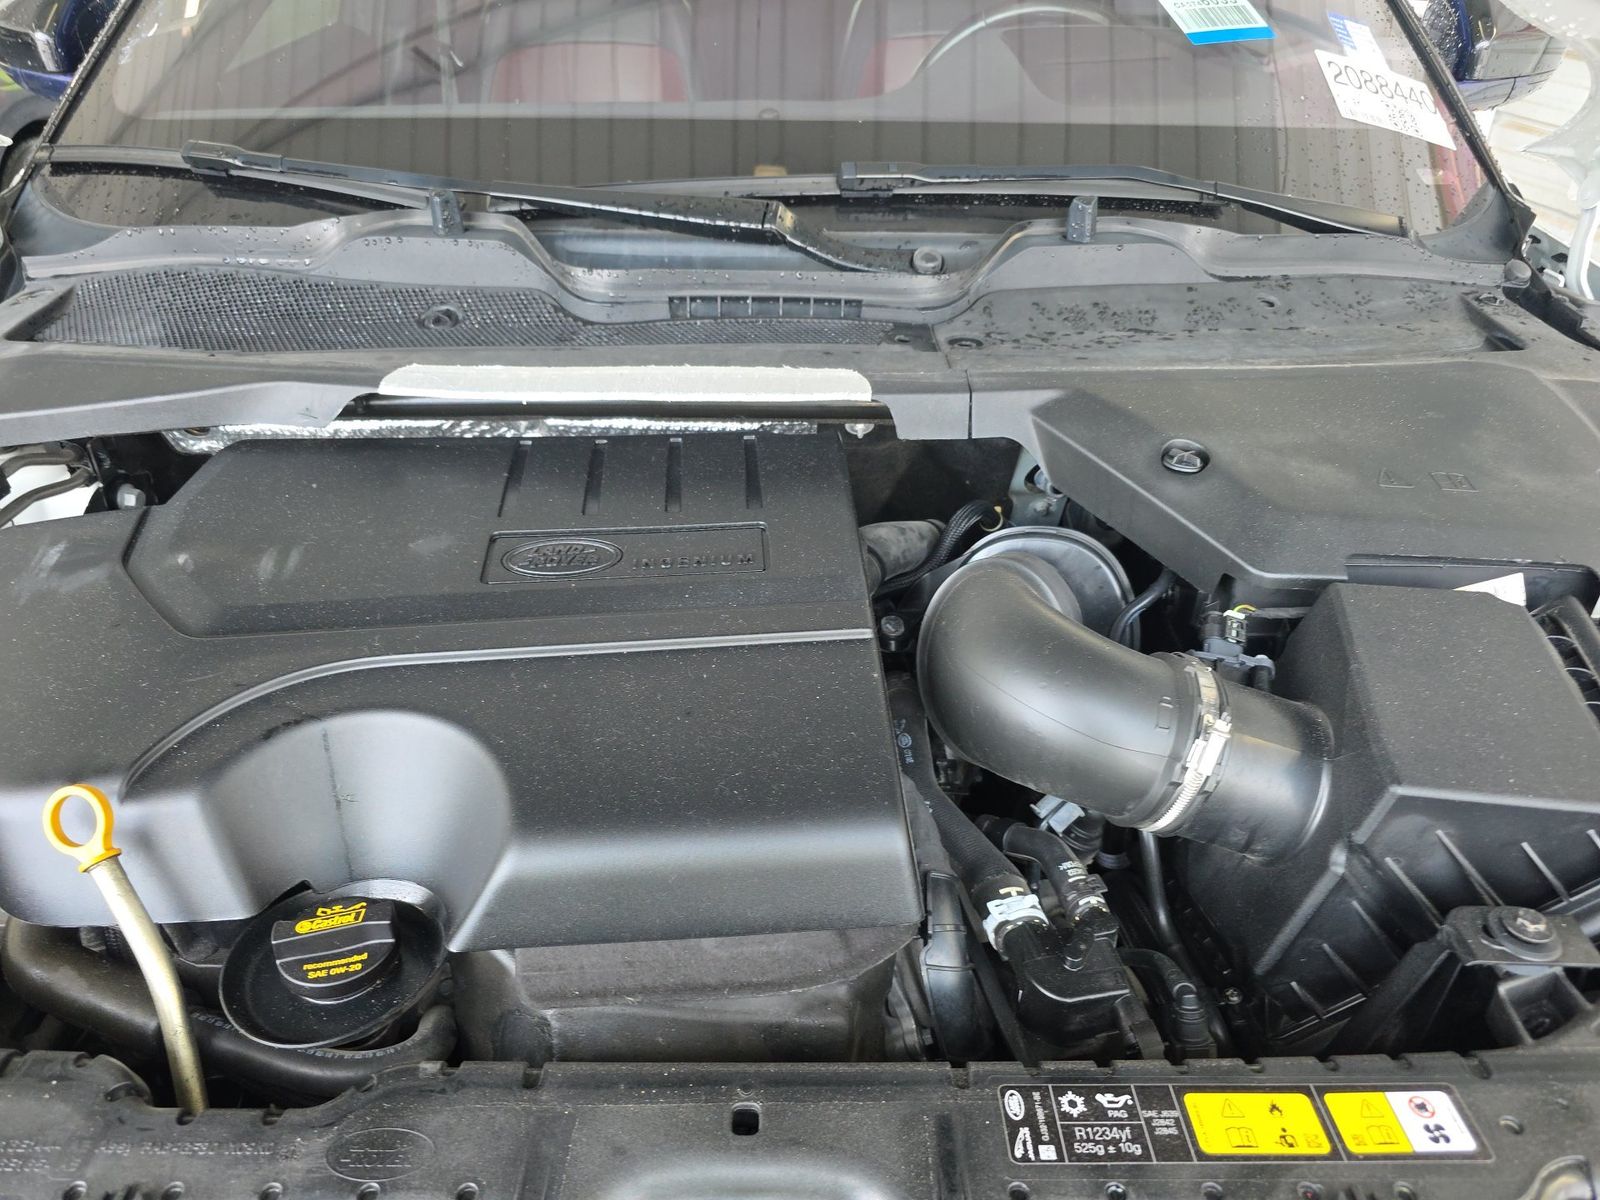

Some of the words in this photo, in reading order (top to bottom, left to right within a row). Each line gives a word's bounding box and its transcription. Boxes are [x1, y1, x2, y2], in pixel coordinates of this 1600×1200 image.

[1327, 60, 1438, 115] 2088440
[312, 912, 356, 930] Castrol
[303, 952, 368, 970] recommended
[307, 969, 329, 979] SAE
[329, 963, 362, 975] 0W-20
[1107, 1110, 1128, 1118] PAG
[1074, 1127, 1132, 1142] R1234yf
[1073, 1142, 1105, 1156] 525g
[1118, 1142, 1143, 1156] 10g
